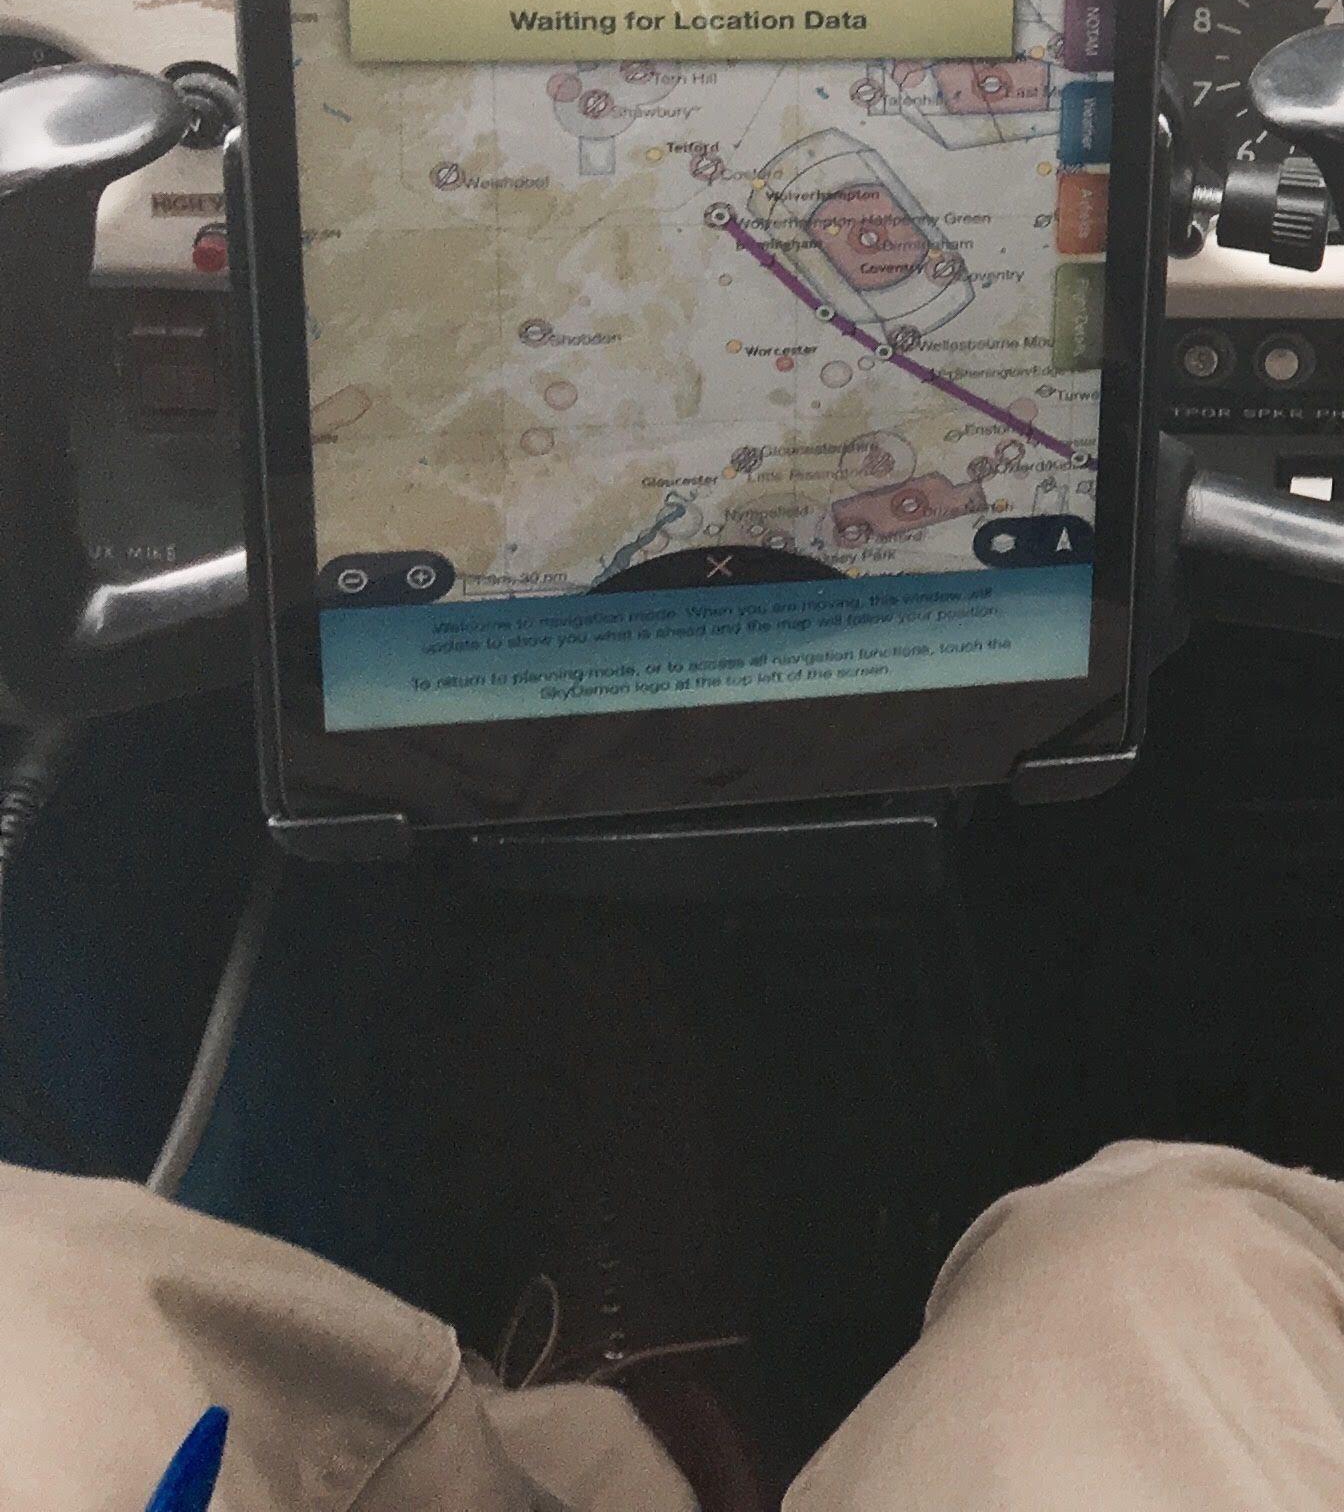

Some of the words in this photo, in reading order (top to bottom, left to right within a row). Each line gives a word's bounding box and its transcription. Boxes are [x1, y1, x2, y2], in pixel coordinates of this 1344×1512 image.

[510, 8, 620, 34] Waiting
[627, 9, 665, 32] for
[675, 9, 794, 34] Location
[804, 9, 866, 32] Data
[745, 343, 818, 358] Worcester
